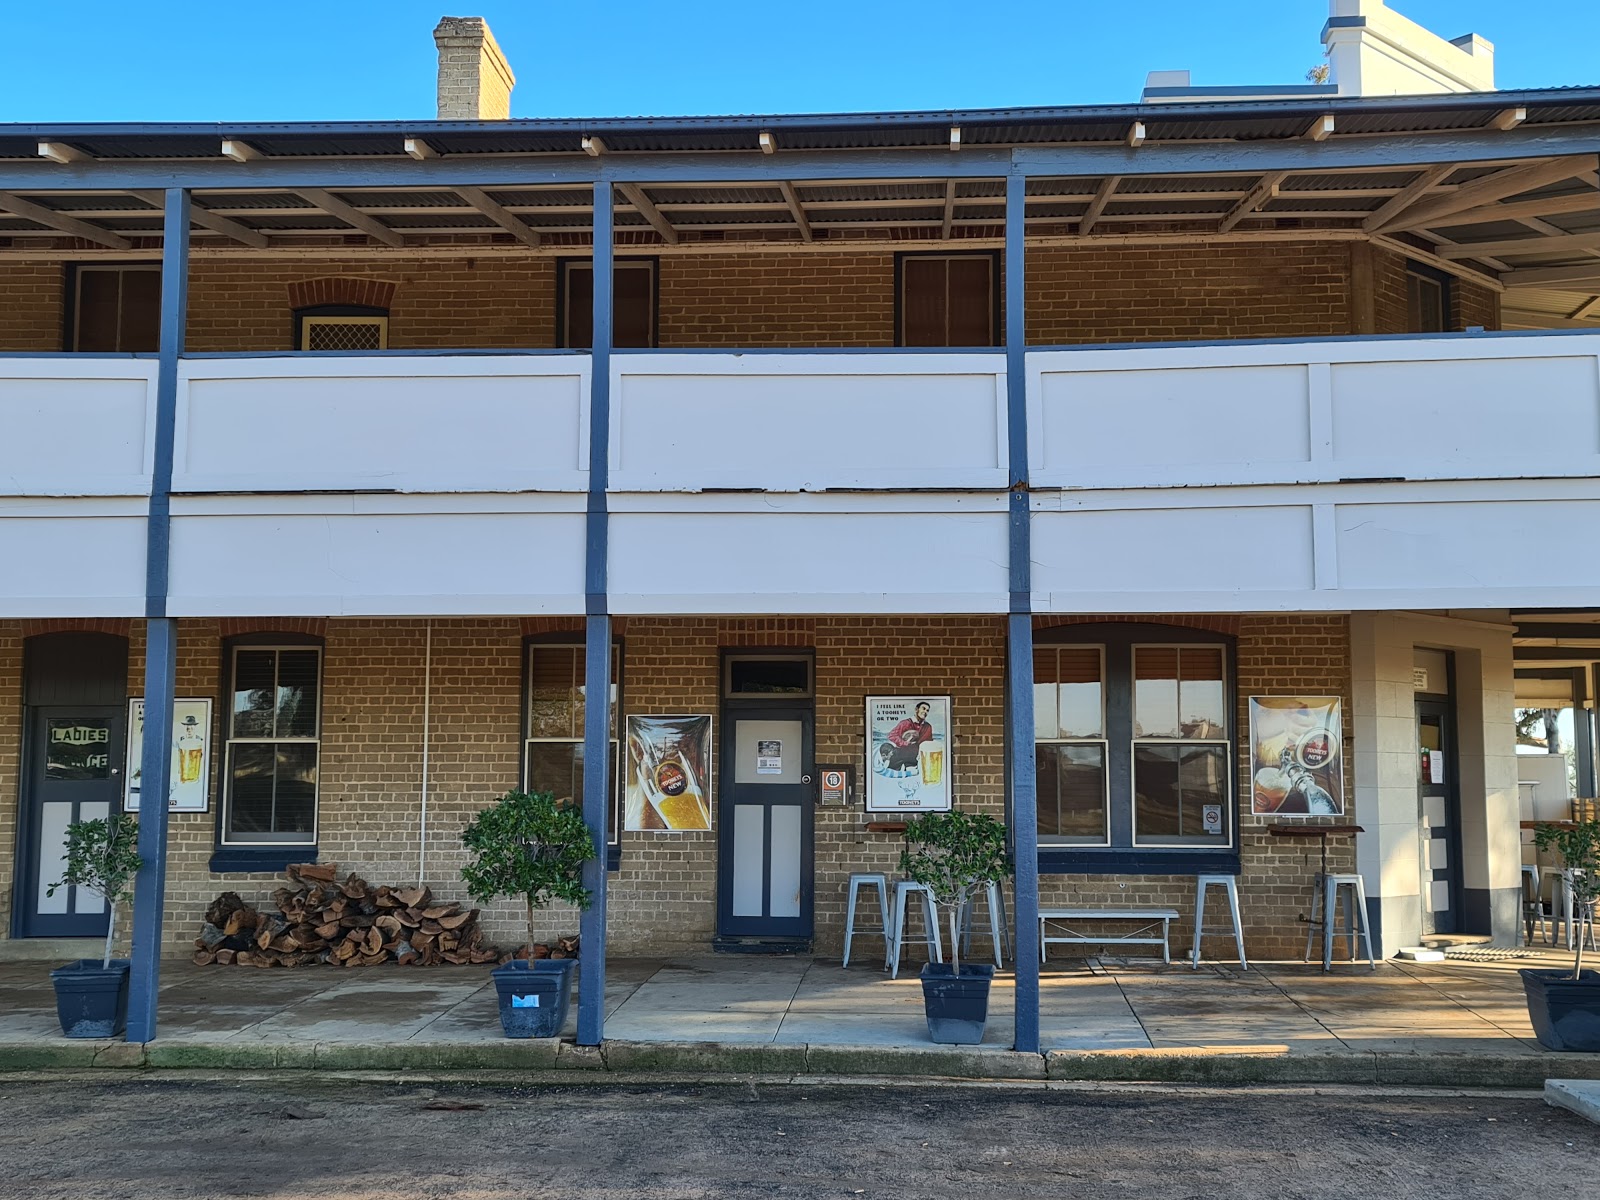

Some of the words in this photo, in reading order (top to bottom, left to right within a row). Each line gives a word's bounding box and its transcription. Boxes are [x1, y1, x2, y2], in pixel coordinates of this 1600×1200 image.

[53, 729, 107, 741] LADIES
[668, 781, 682, 791] NEW
[829, 777, 838, 785] 18
